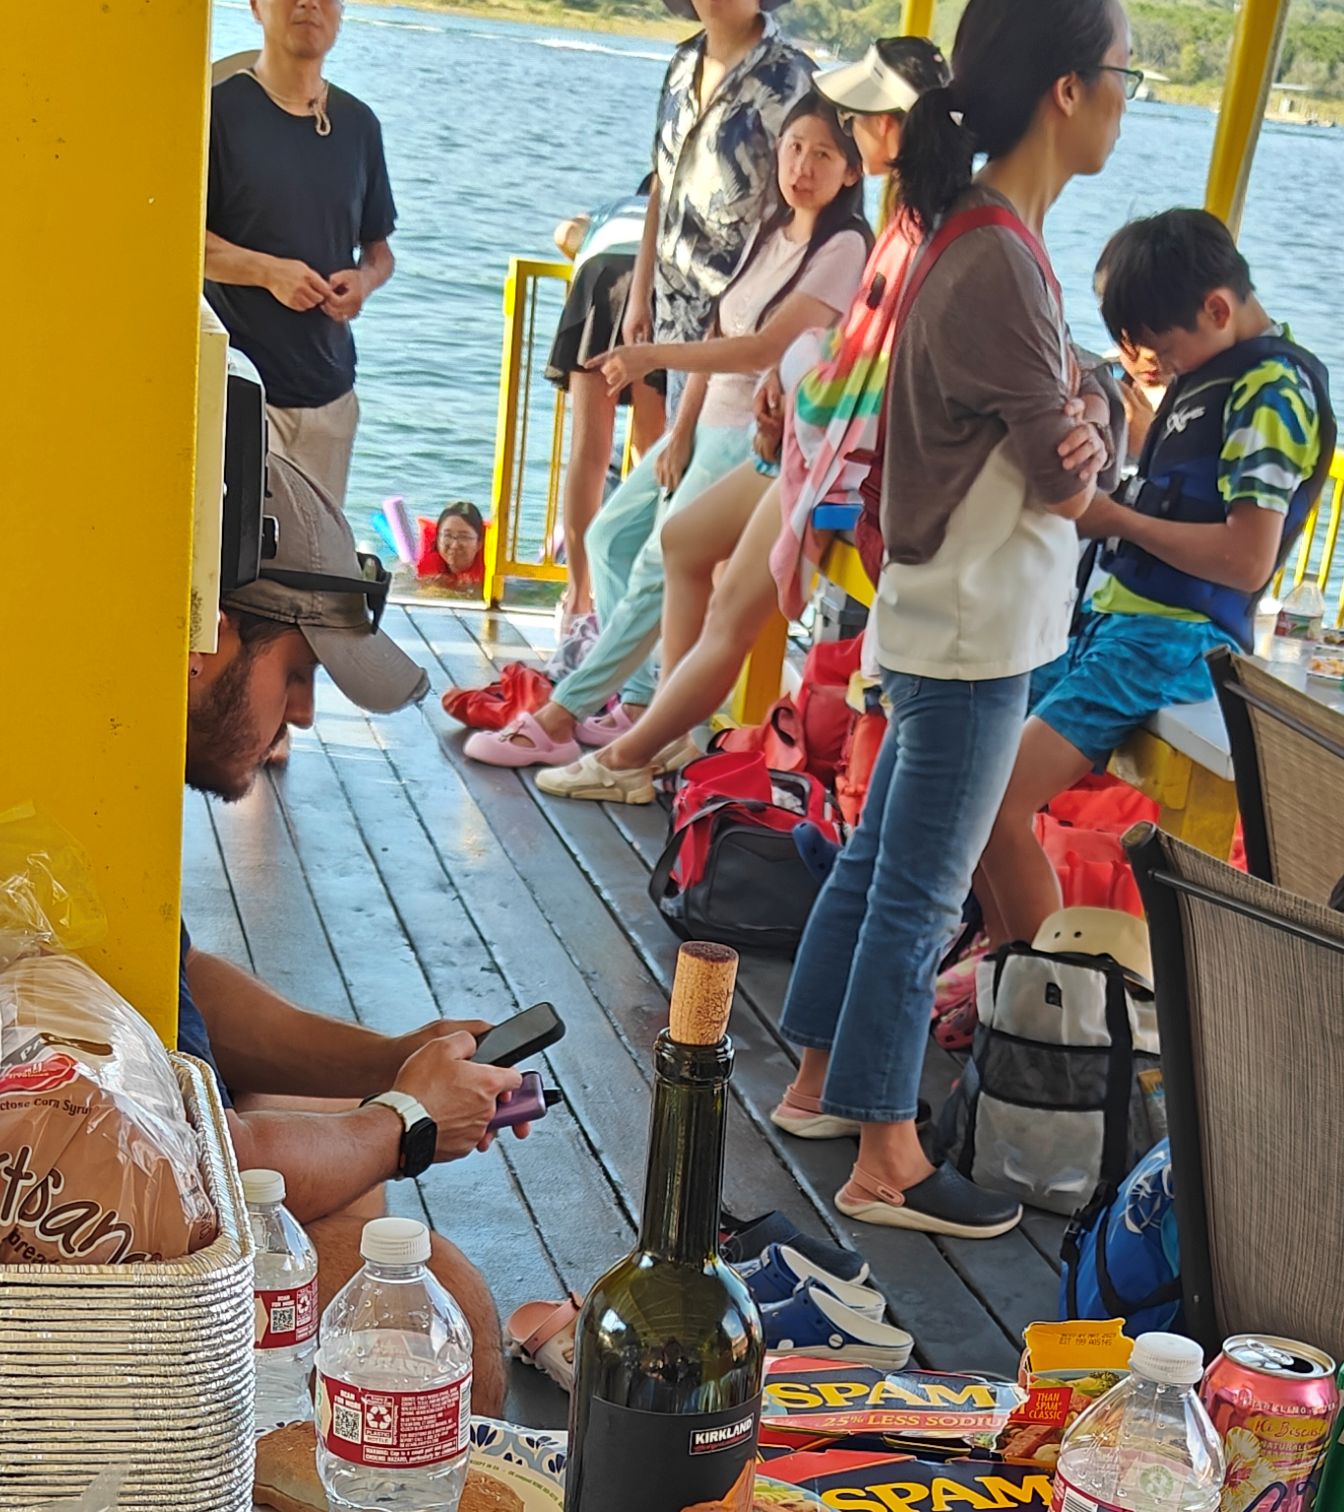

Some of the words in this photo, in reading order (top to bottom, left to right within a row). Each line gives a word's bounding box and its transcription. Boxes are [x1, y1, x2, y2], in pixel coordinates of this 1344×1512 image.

[34, 1098, 60, 1109] Corn
[763, 1380, 999, 1409] SPAM
[1037, 1392, 1060, 1401] THAN
[822, 1415, 865, 1427] 25%
[868, 1414, 921, 1427] LESS
[925, 1415, 1009, 1428] SODIU
[1028, 1410, 1062, 1420] CLASSIC
[695, 1418, 752, 1445] KIRKLAND
